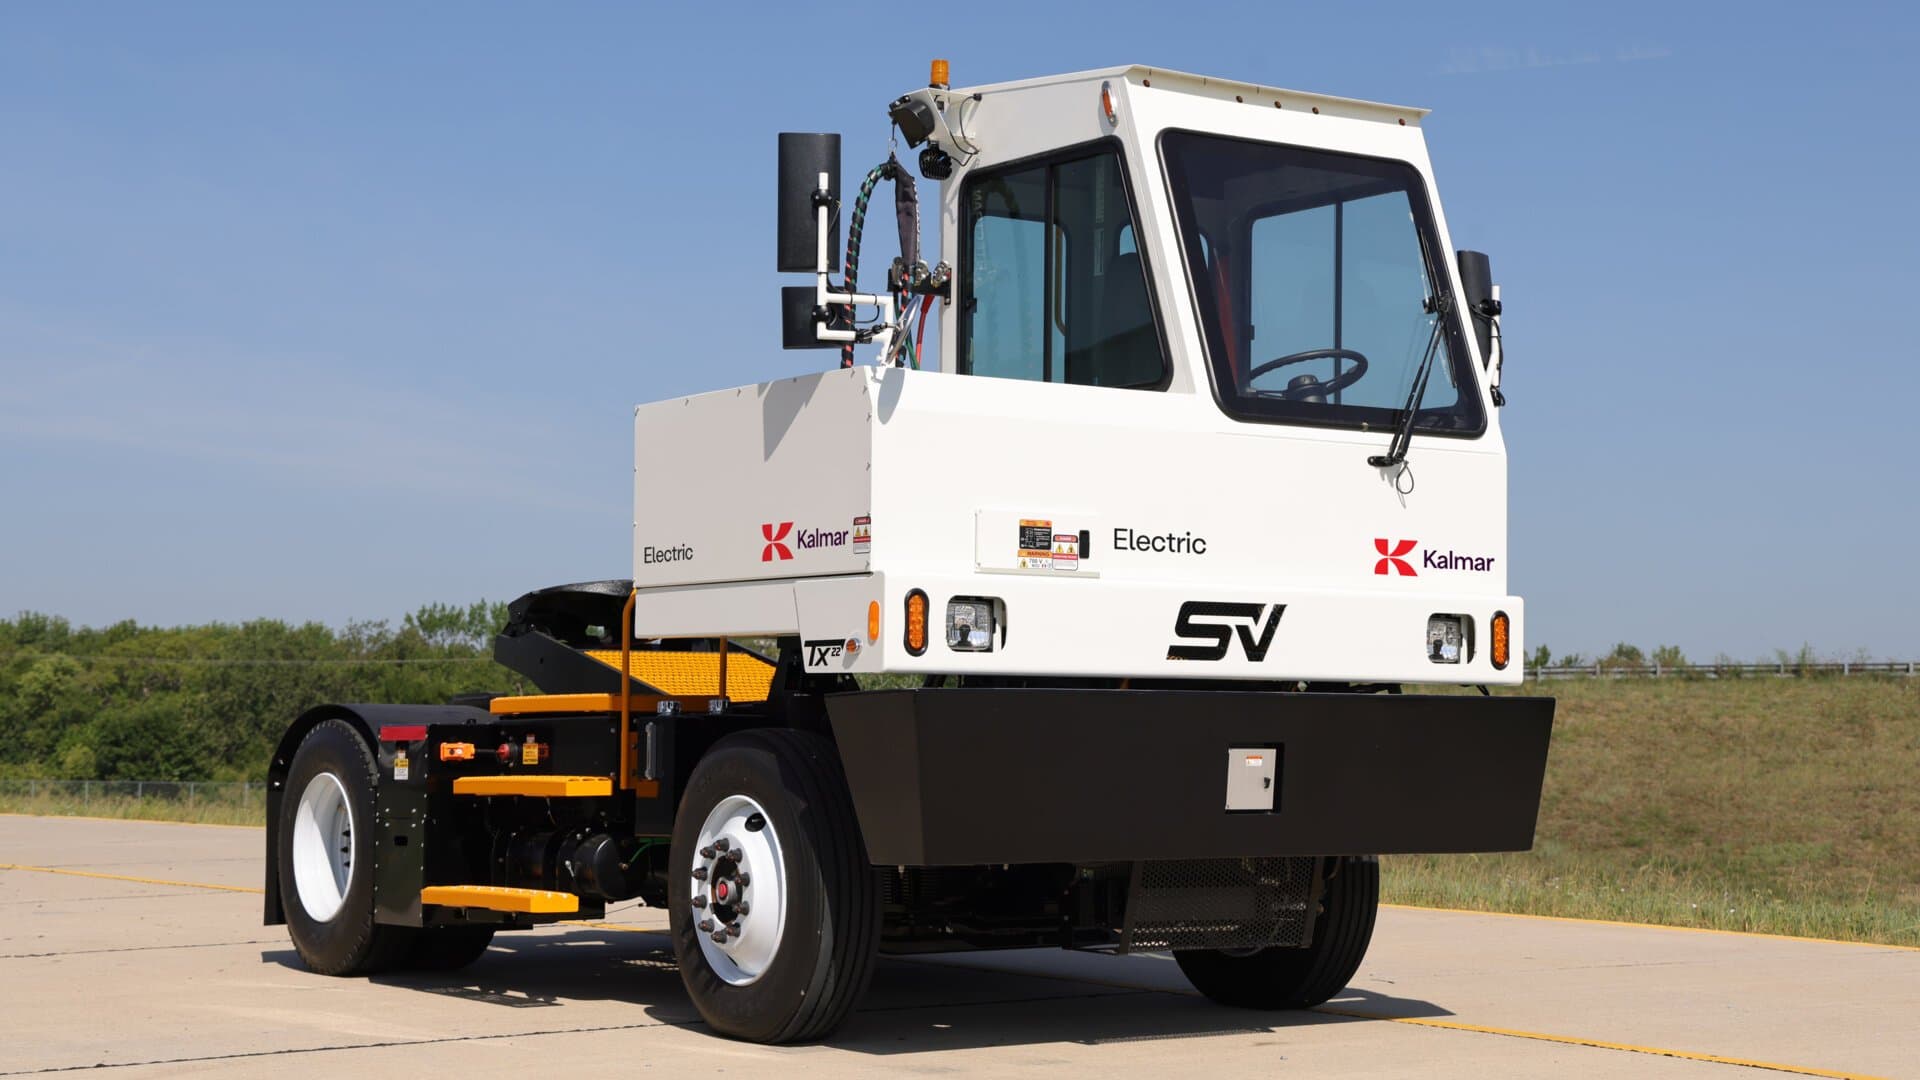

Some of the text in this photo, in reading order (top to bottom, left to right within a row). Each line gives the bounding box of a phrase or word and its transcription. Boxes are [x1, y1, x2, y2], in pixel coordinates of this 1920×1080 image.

[797, 527, 849, 550] Kalmar
[1113, 527, 1207, 555] Electric
[644, 544, 694, 564] Electric
[1423, 549, 1495, 572] Kalmar
[1165, 600, 1288, 662] SV
